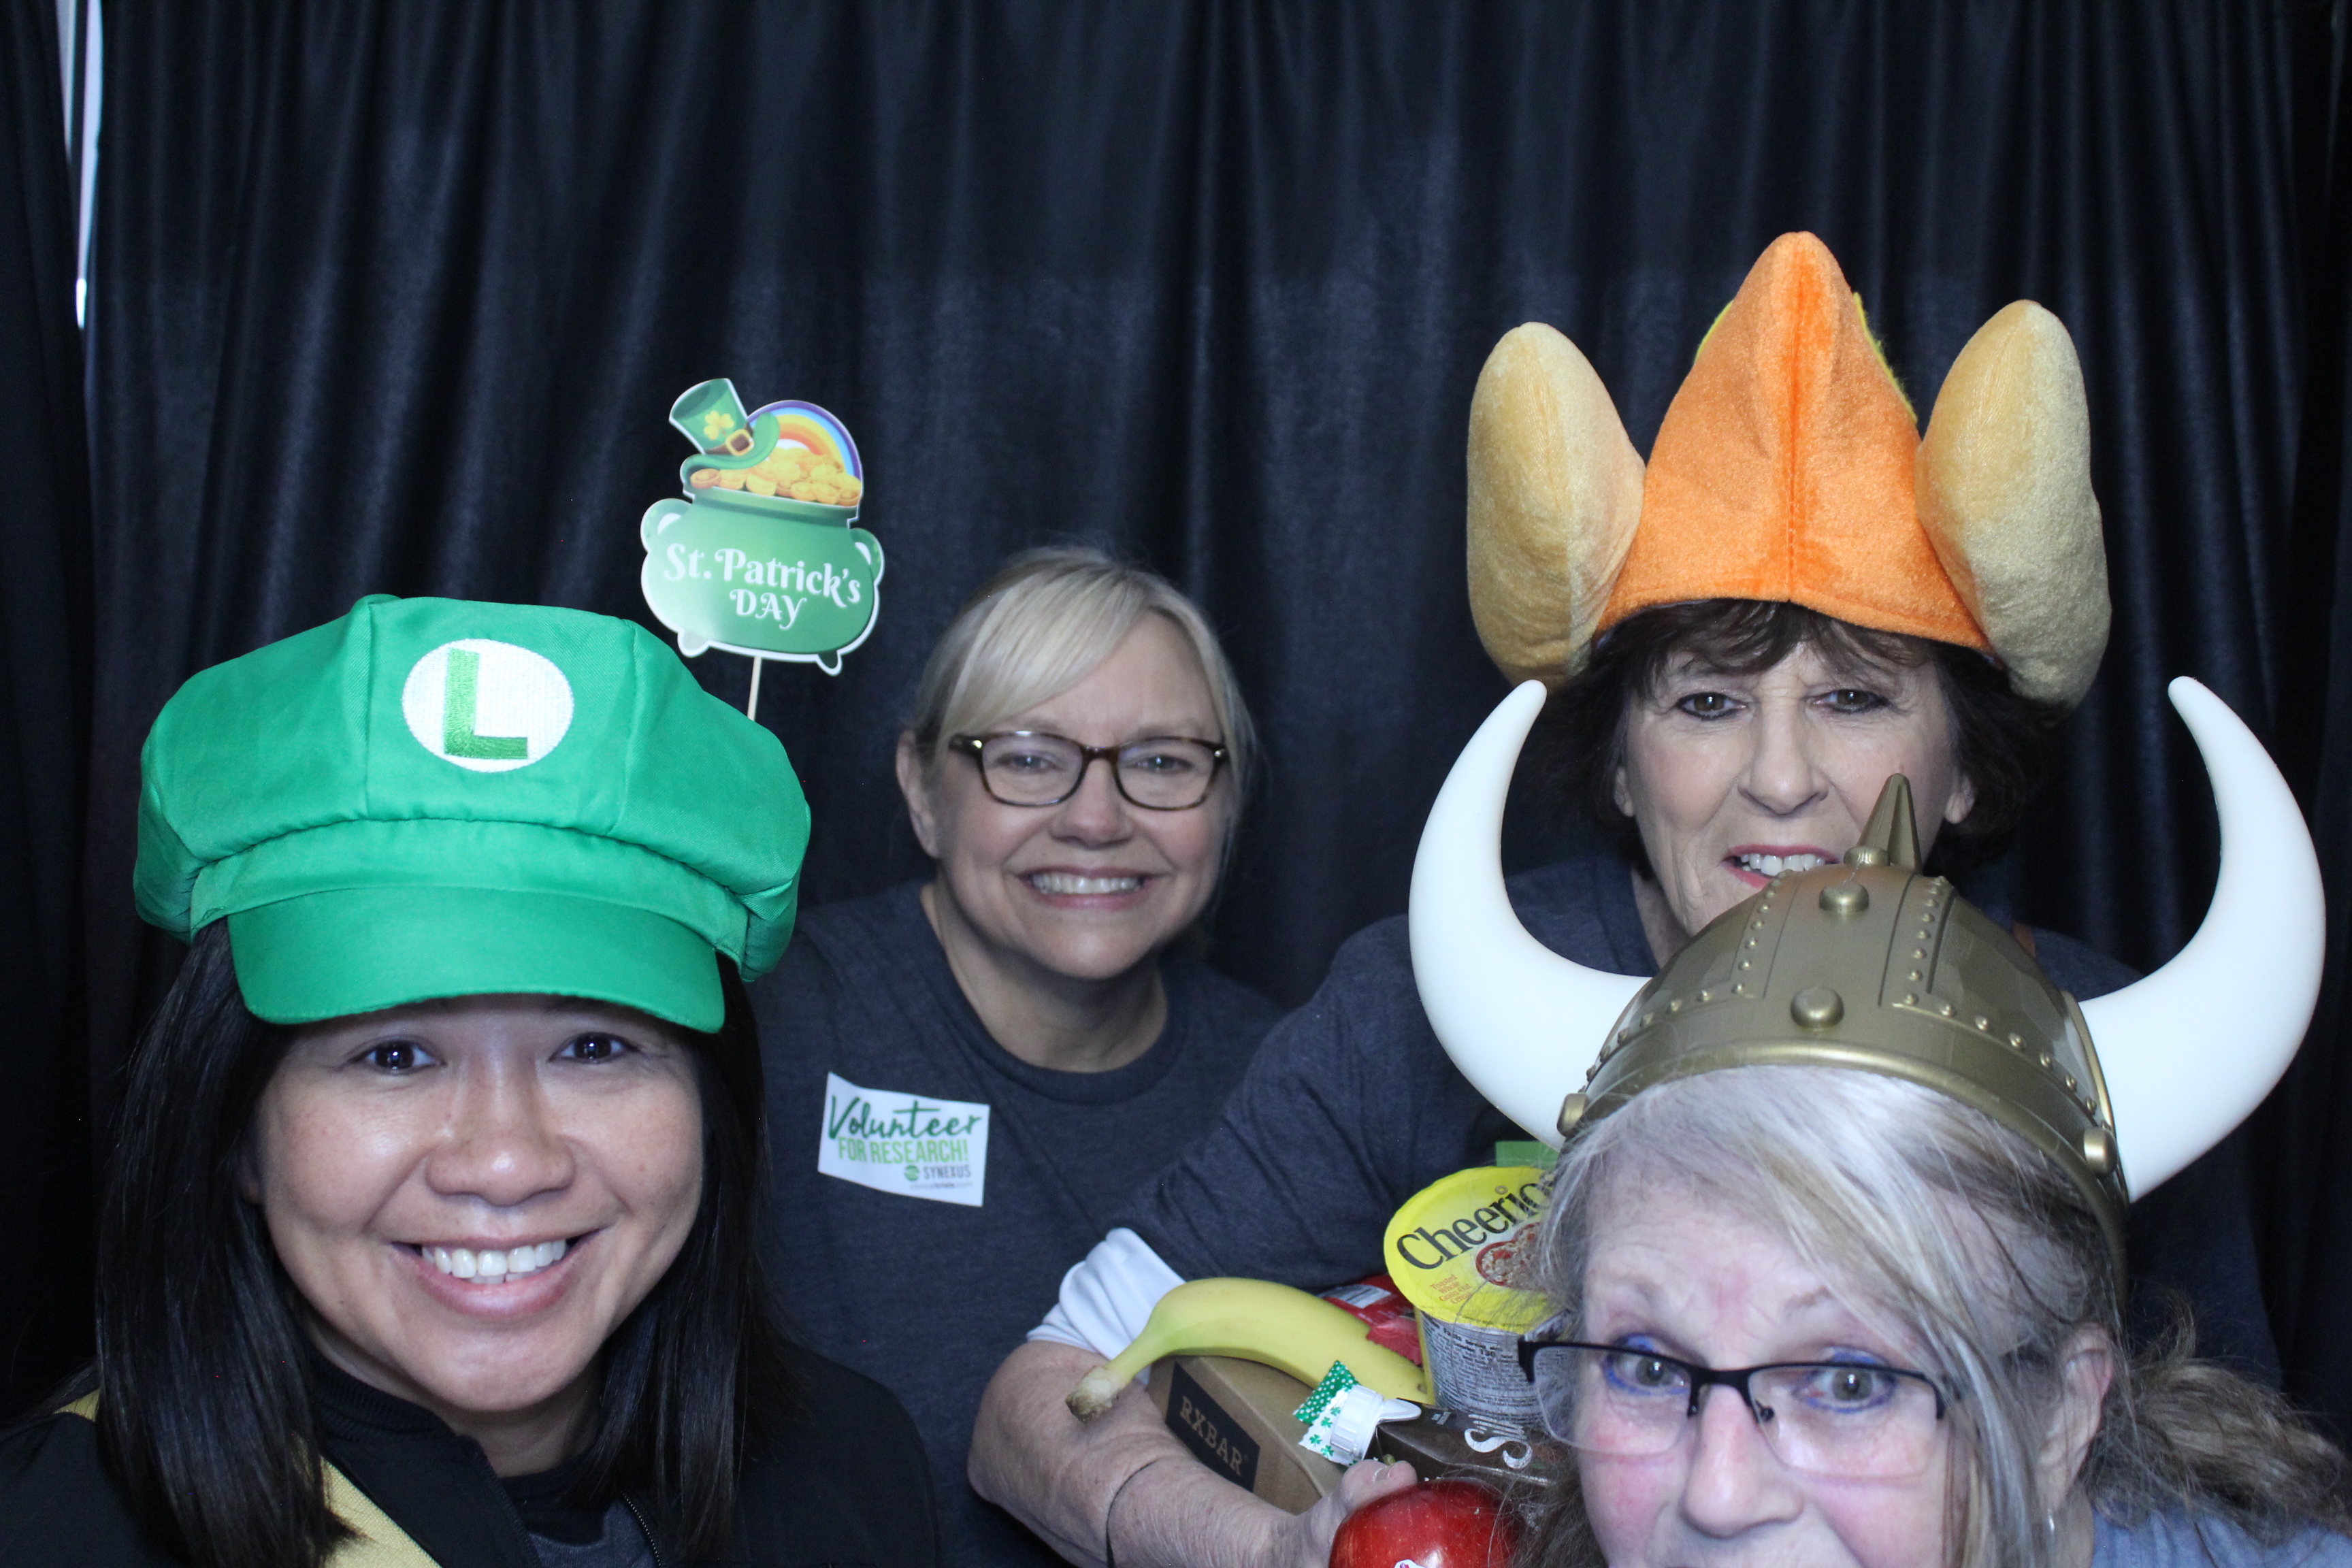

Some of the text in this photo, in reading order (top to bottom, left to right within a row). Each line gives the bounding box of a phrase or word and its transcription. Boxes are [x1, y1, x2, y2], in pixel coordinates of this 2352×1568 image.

[664, 543, 861, 608] St. Patrick's
[729, 588, 807, 630] DAY
[444, 647, 528, 760] L
[828, 1095, 983, 1139] Volunteer
[838, 1136, 970, 1164] FOR RESEARCH!
[922, 1164, 972, 1179] SYNEXUS
[1396, 1171, 1558, 1271] Cheerio
[1179, 1396, 1243, 1477] RXBAR
